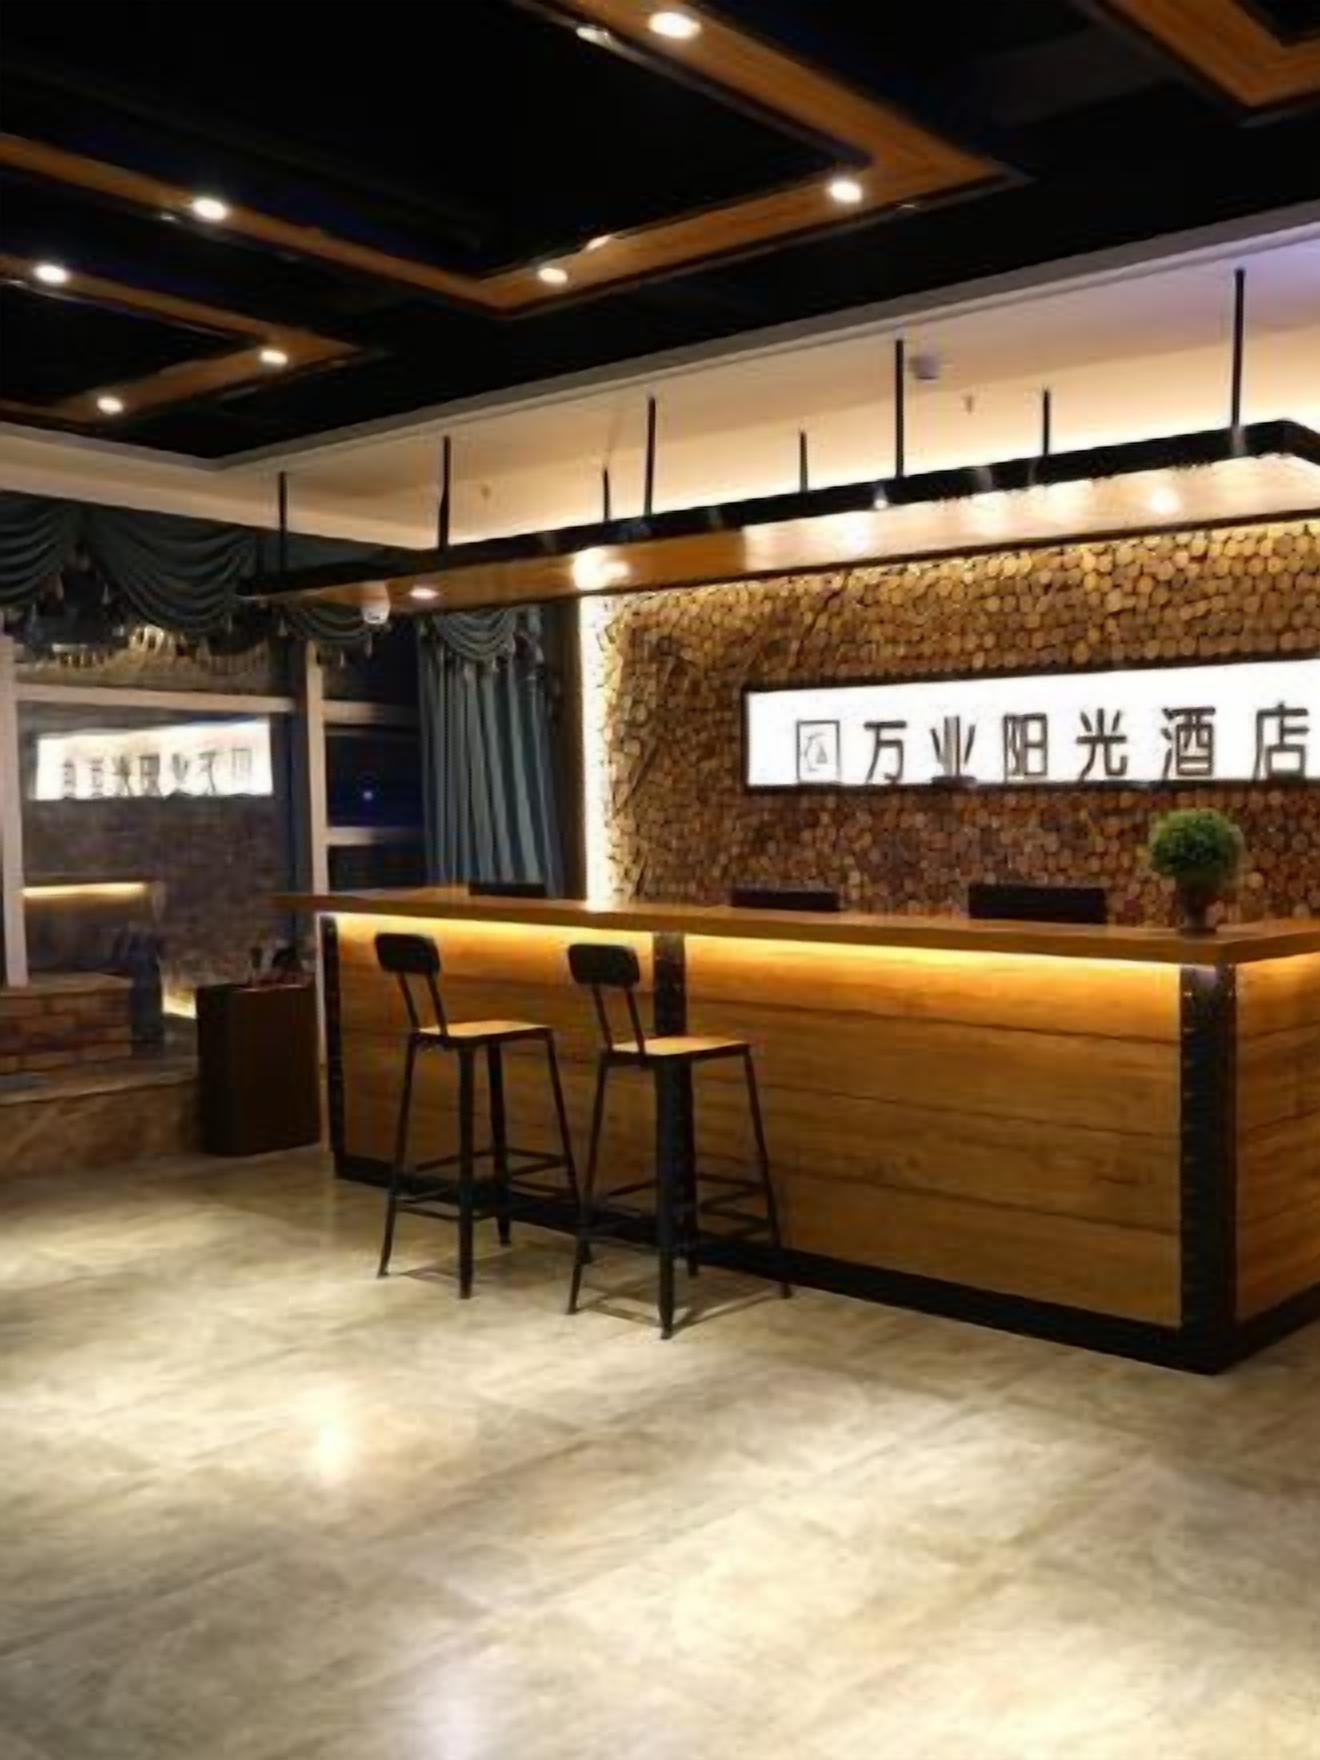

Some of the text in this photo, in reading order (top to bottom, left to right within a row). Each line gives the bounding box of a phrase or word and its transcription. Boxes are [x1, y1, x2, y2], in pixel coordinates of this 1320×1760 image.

[864, 703, 1310, 784] 万业阳光酒店
